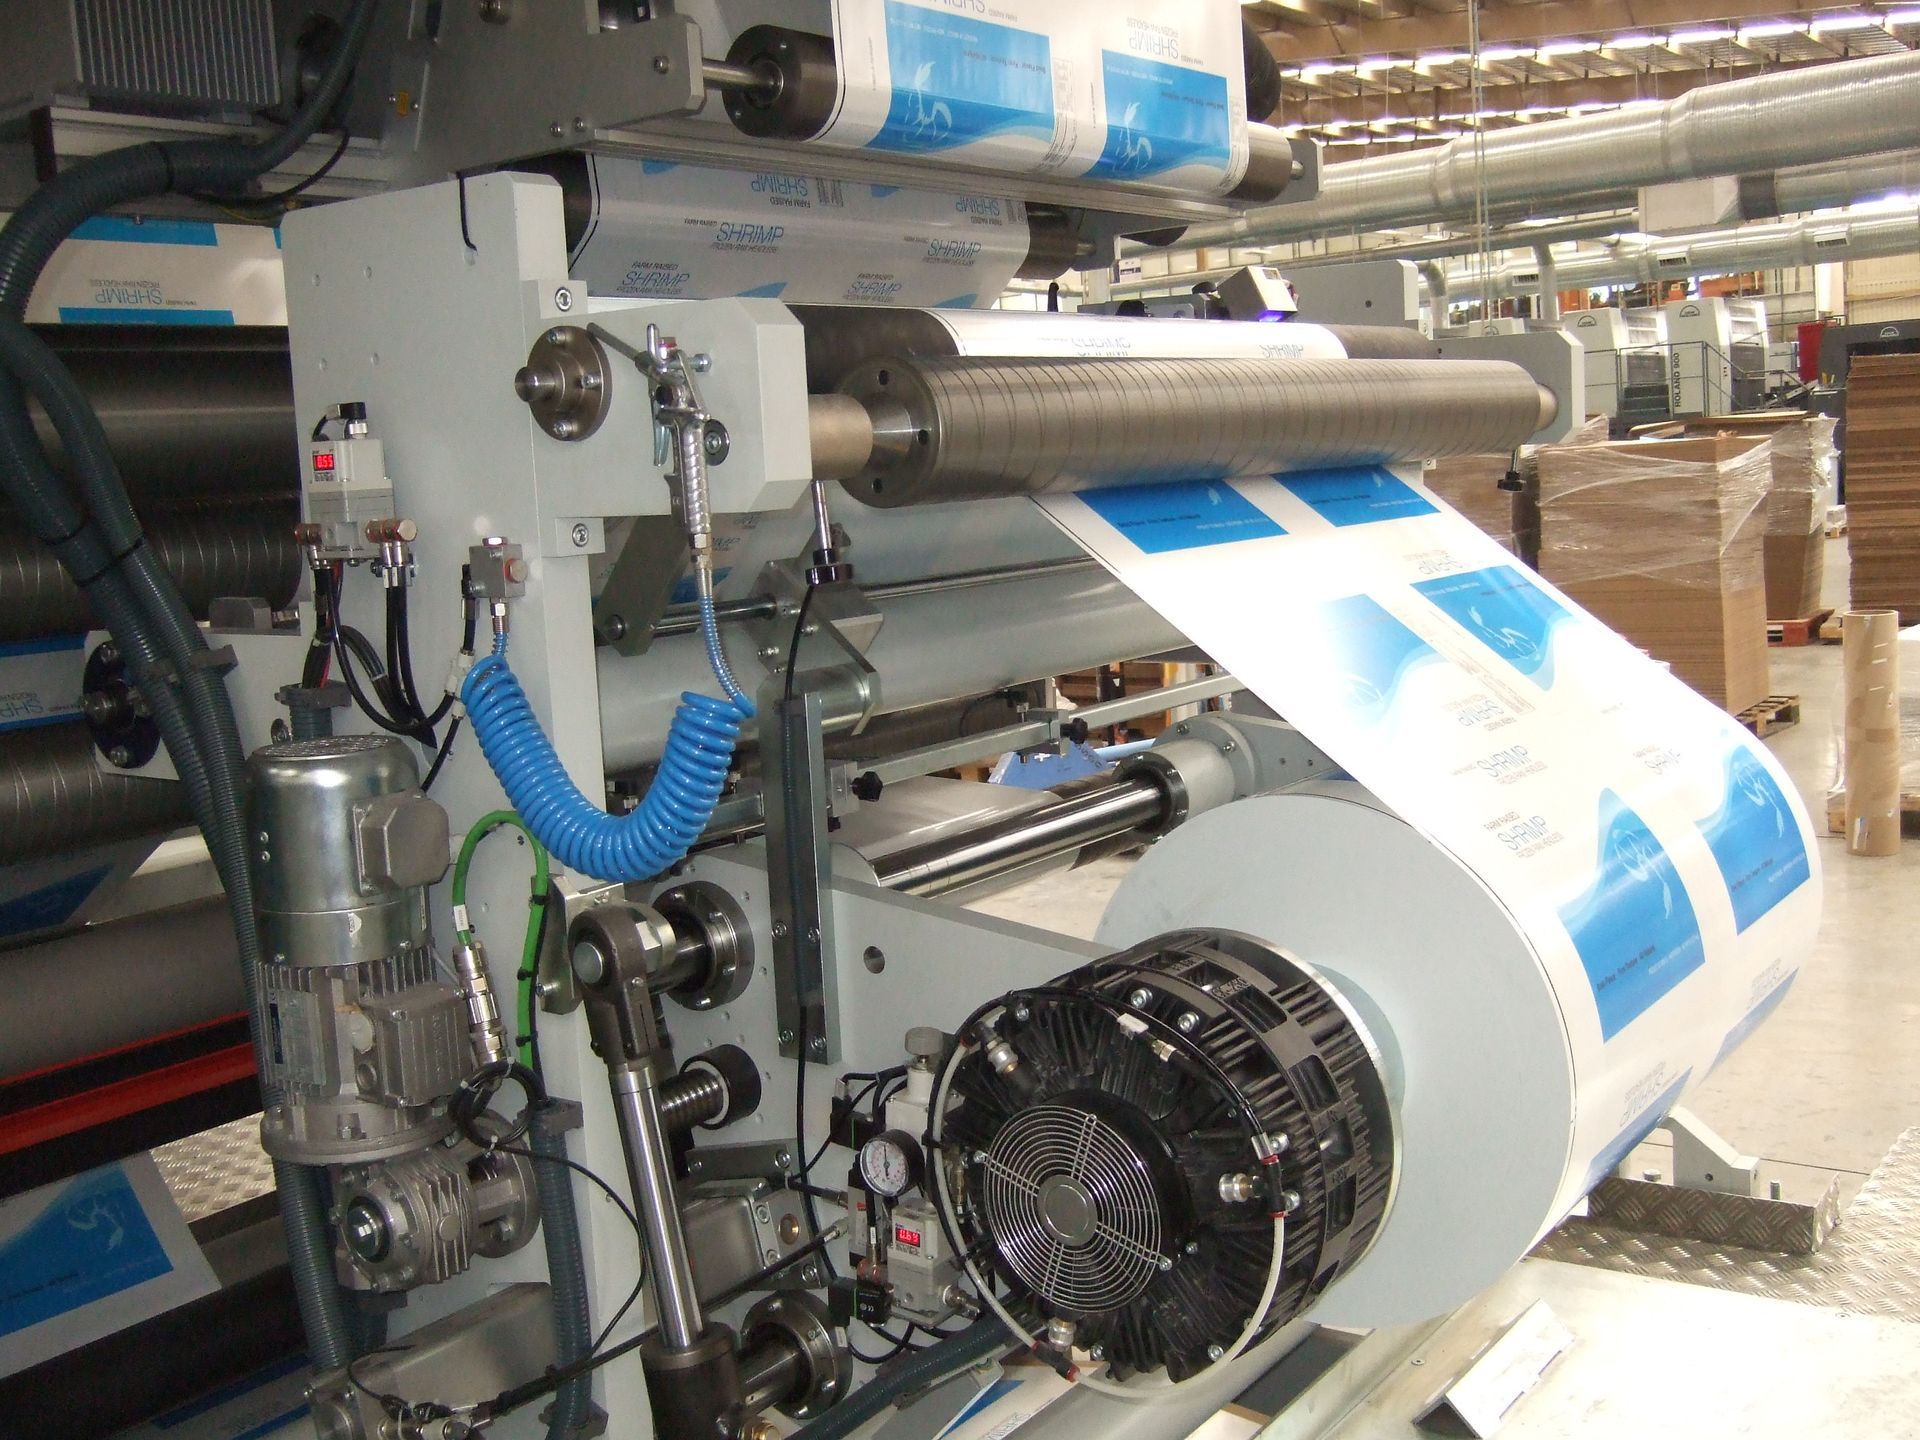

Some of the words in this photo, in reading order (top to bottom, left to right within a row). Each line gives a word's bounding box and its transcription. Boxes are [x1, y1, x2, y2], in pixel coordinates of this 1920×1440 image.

[1129, 30, 1179, 60] SHRIMP
[751, 176, 808, 198] SHRIMP
[955, 197, 1000, 216] SHRIMP
[717, 222, 784, 245] SHRIMP
[928, 239, 981, 258] SHRIMP
[622, 271, 690, 287] SHRIMP
[851, 280, 902, 296] SHRIMP
[95, 287, 163, 305] SHRIMP
[1258, 344, 1304, 359] SHRIMP
[1672, 352, 1682, 369] 900
[1672, 371, 1682, 408] ROLAND
[1459, 700, 1505, 727] SHRIMP
[1477, 745, 1531, 778] SHRIMP
[1497, 815, 1549, 851] SHRIMP
